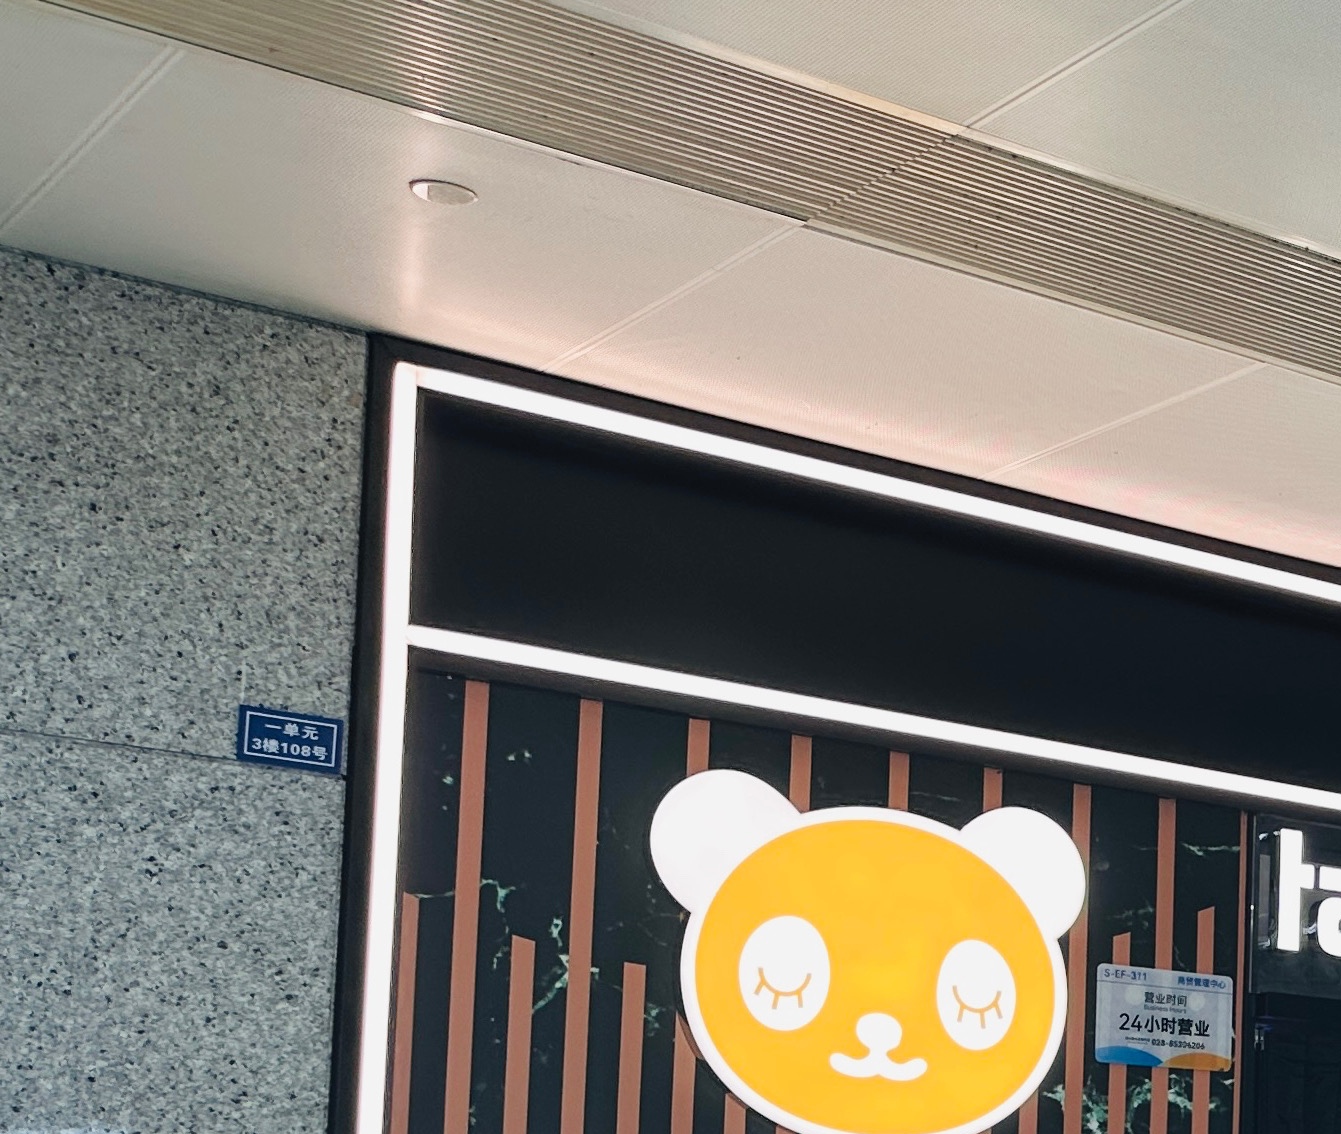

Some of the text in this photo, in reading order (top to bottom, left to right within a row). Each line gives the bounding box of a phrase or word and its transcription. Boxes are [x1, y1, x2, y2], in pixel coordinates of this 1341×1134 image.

[264, 722, 319, 741] 一单元
[1144, 991, 1188, 1007] 营业时间
[1119, 1013, 1211, 1038] 24小时营业
